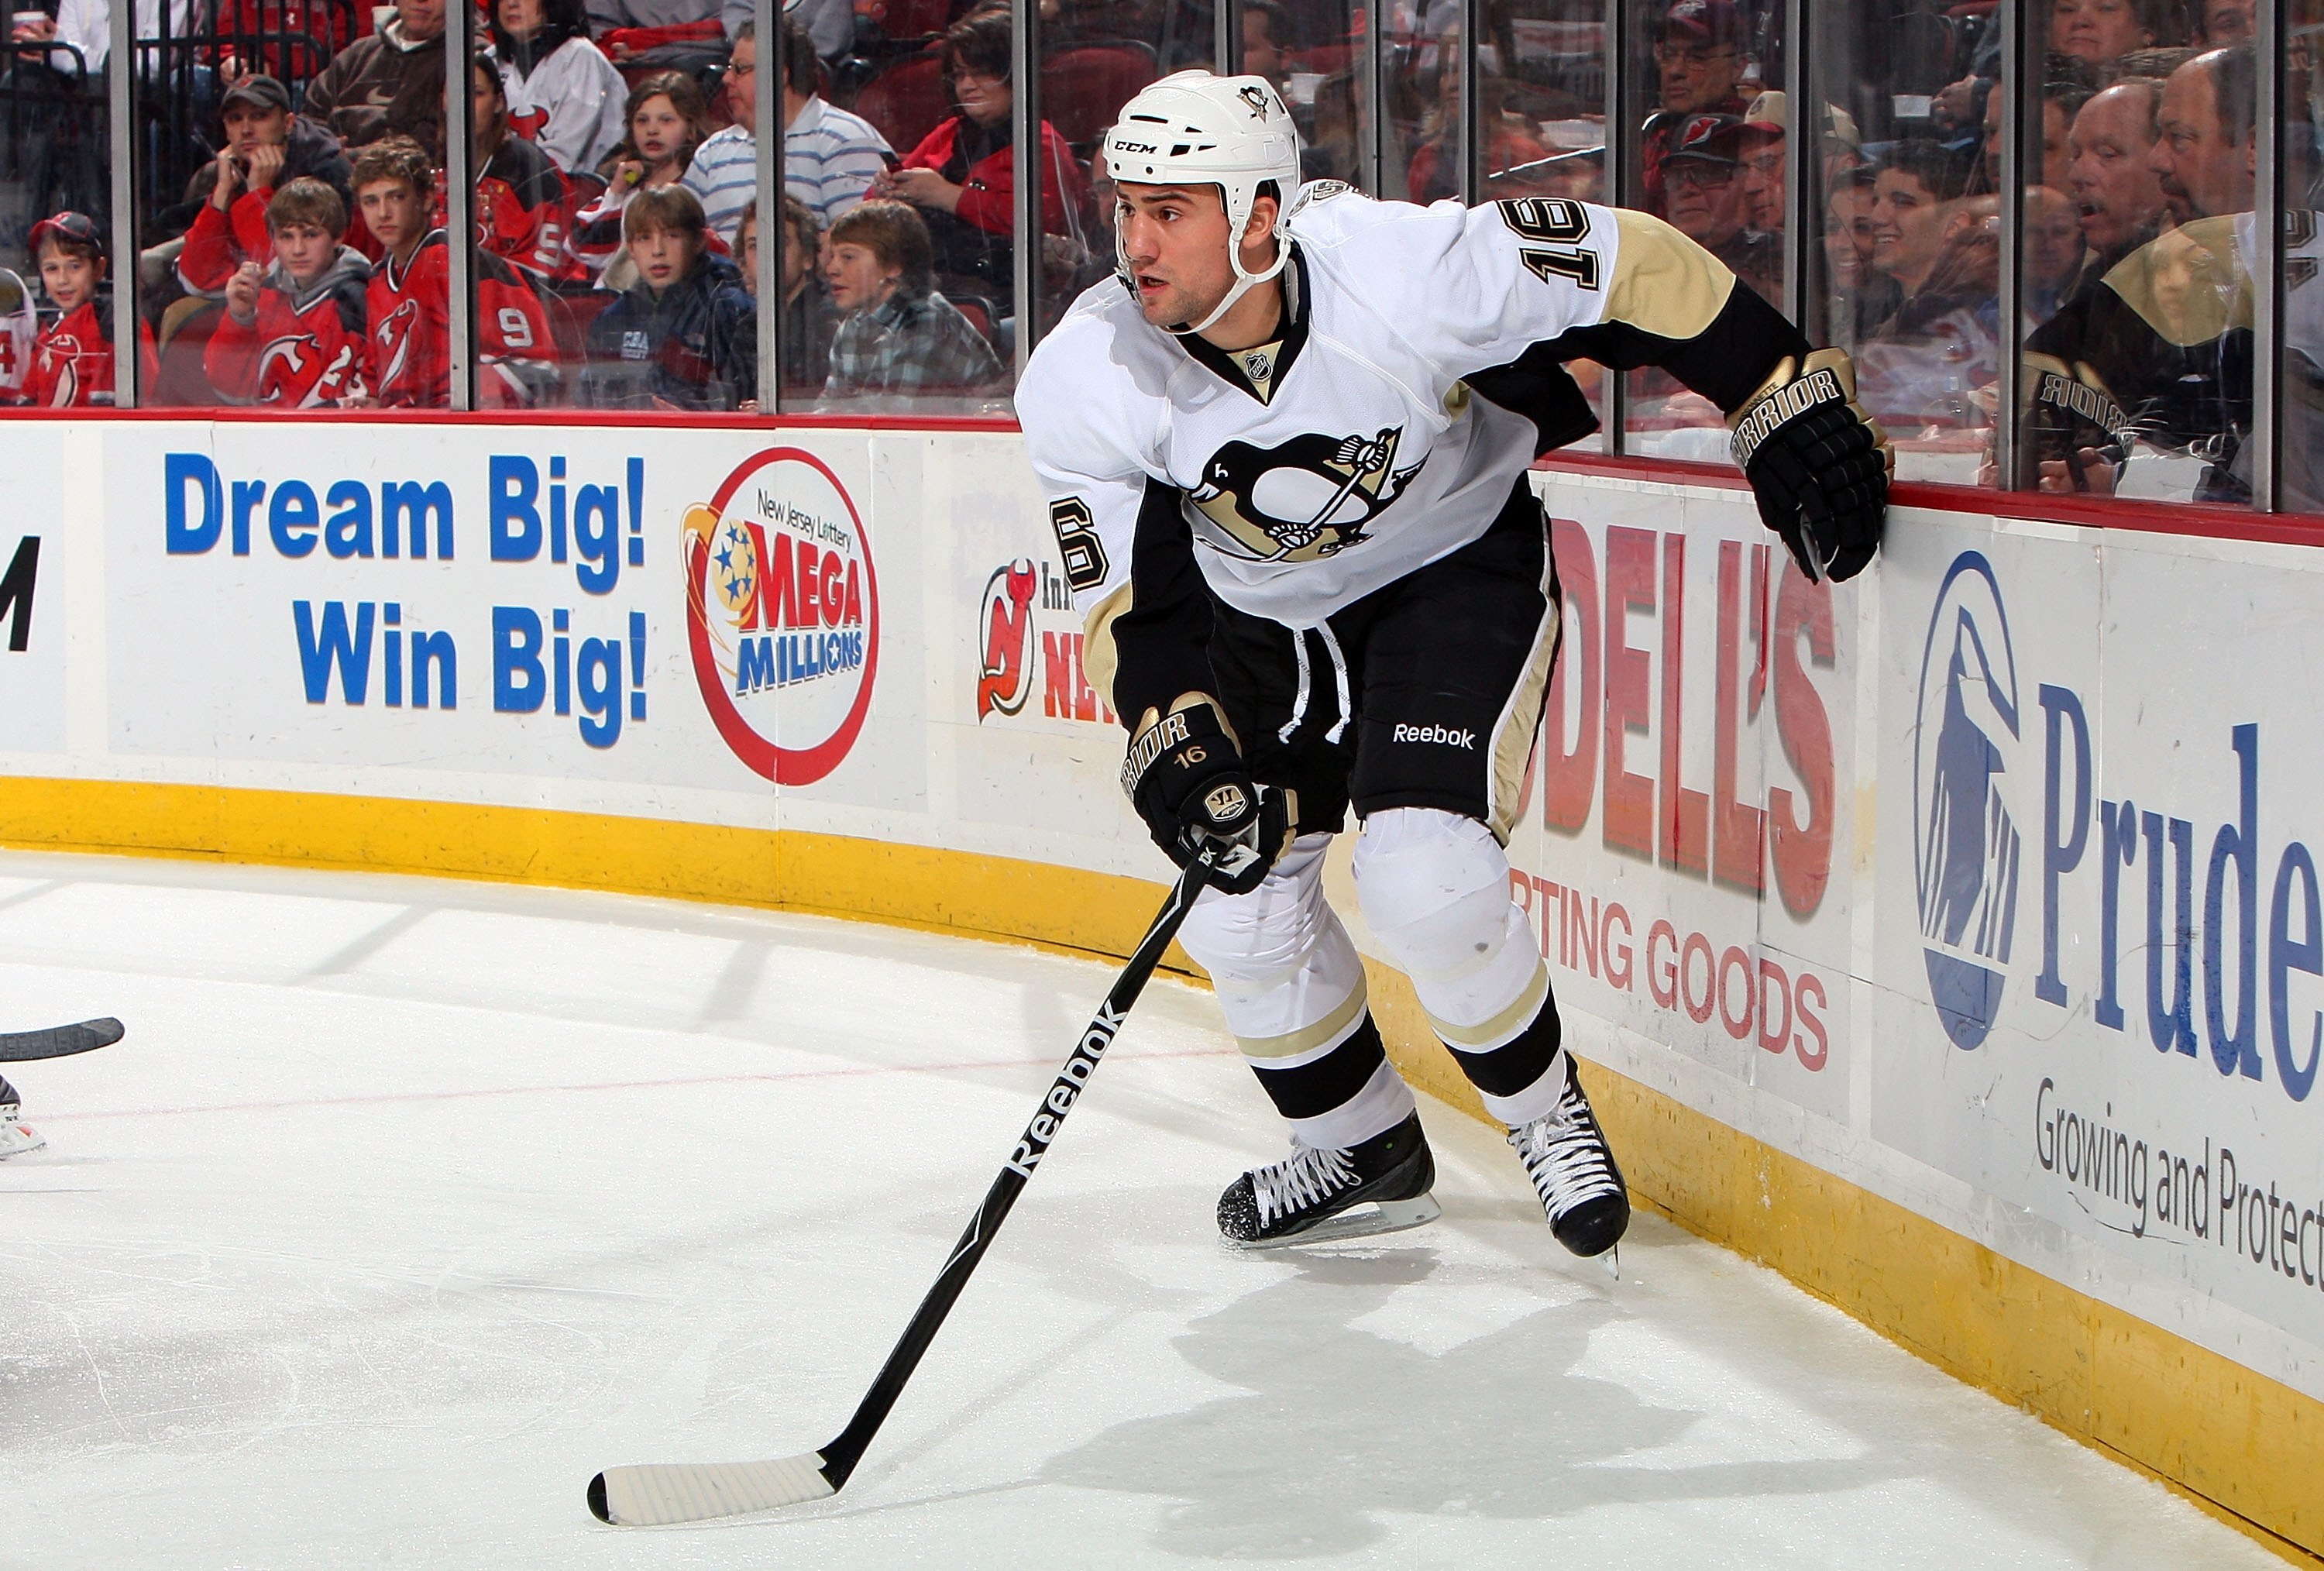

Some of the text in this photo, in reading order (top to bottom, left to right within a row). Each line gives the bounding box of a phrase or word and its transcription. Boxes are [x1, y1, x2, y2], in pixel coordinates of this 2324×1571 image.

[1115, 140, 1158, 154] CCM
[1495, 197, 1600, 291] 16
[497, 308, 534, 347] 9
[164, 452, 645, 596] Dream Big!
[758, 488, 852, 553] New Jersey Lottery
[1050, 496, 1110, 593] 6
[739, 520, 863, 633] MEGA
[293, 600, 648, 749] Win Big!
[736, 631, 863, 696] MILLIONS
[1173, 746, 1208, 769] 16
[1393, 723, 1476, 751] Reebok
[1516, 517, 1836, 917] DELL'S
[2034, 682, 2324, 1103] Prude
[1646, 919, 1828, 1072] GOODS
[1006, 999, 1128, 1179] Reebok
[2036, 1077, 2148, 1239] Growing
[2156, 1136, 2209, 1240] and
